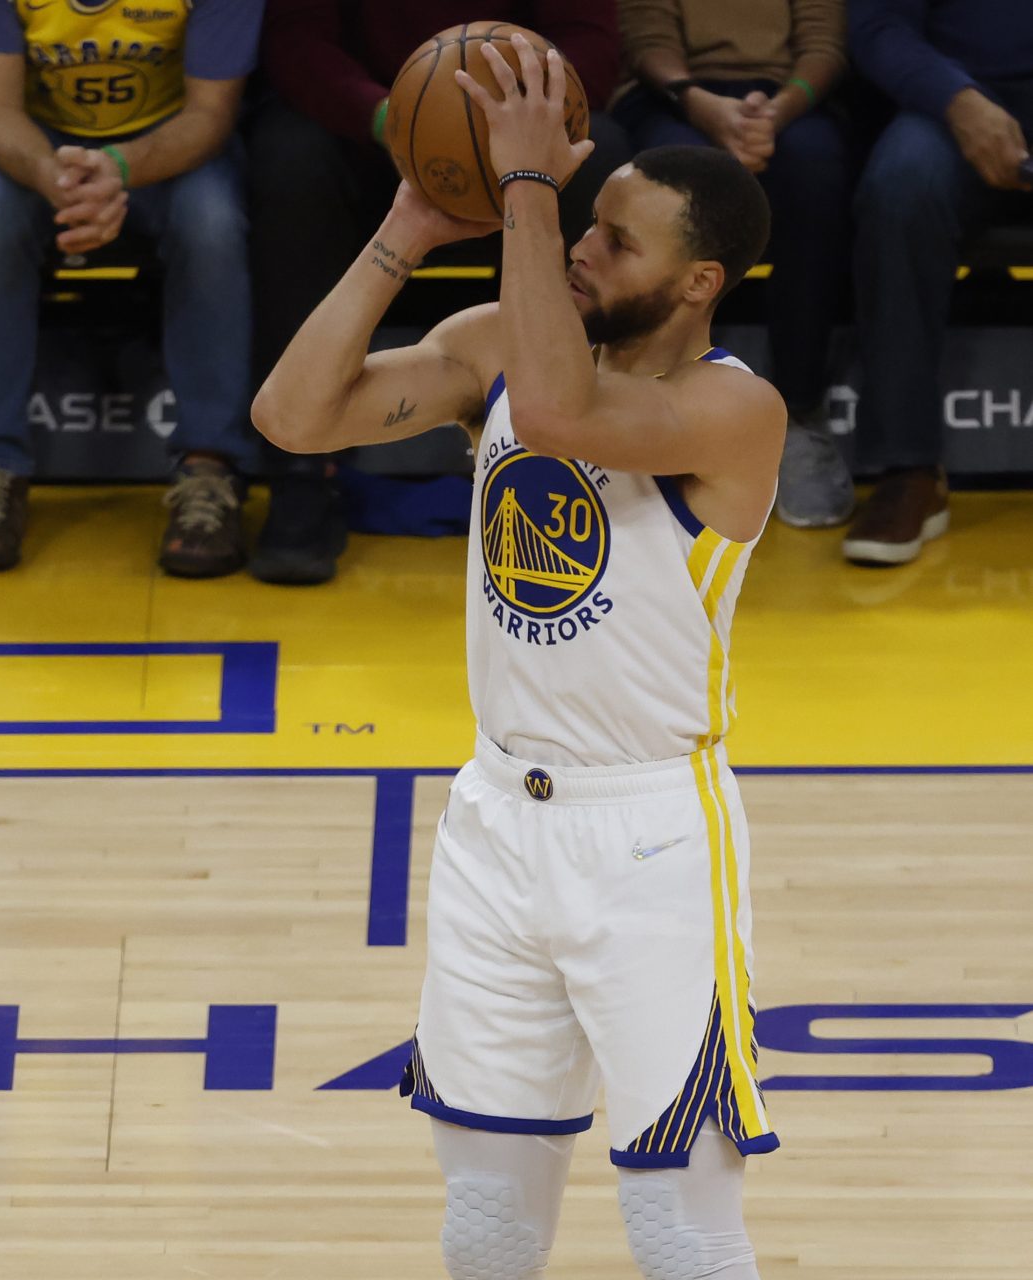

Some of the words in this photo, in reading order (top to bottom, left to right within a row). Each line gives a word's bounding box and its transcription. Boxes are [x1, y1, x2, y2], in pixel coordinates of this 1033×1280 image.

[73, 74, 136, 104] 55
[944, 388, 1033, 428] CH
[482, 436, 522, 470] GOL
[544, 492, 592, 543] 30
[482, 571, 614, 646] WARRIORS
